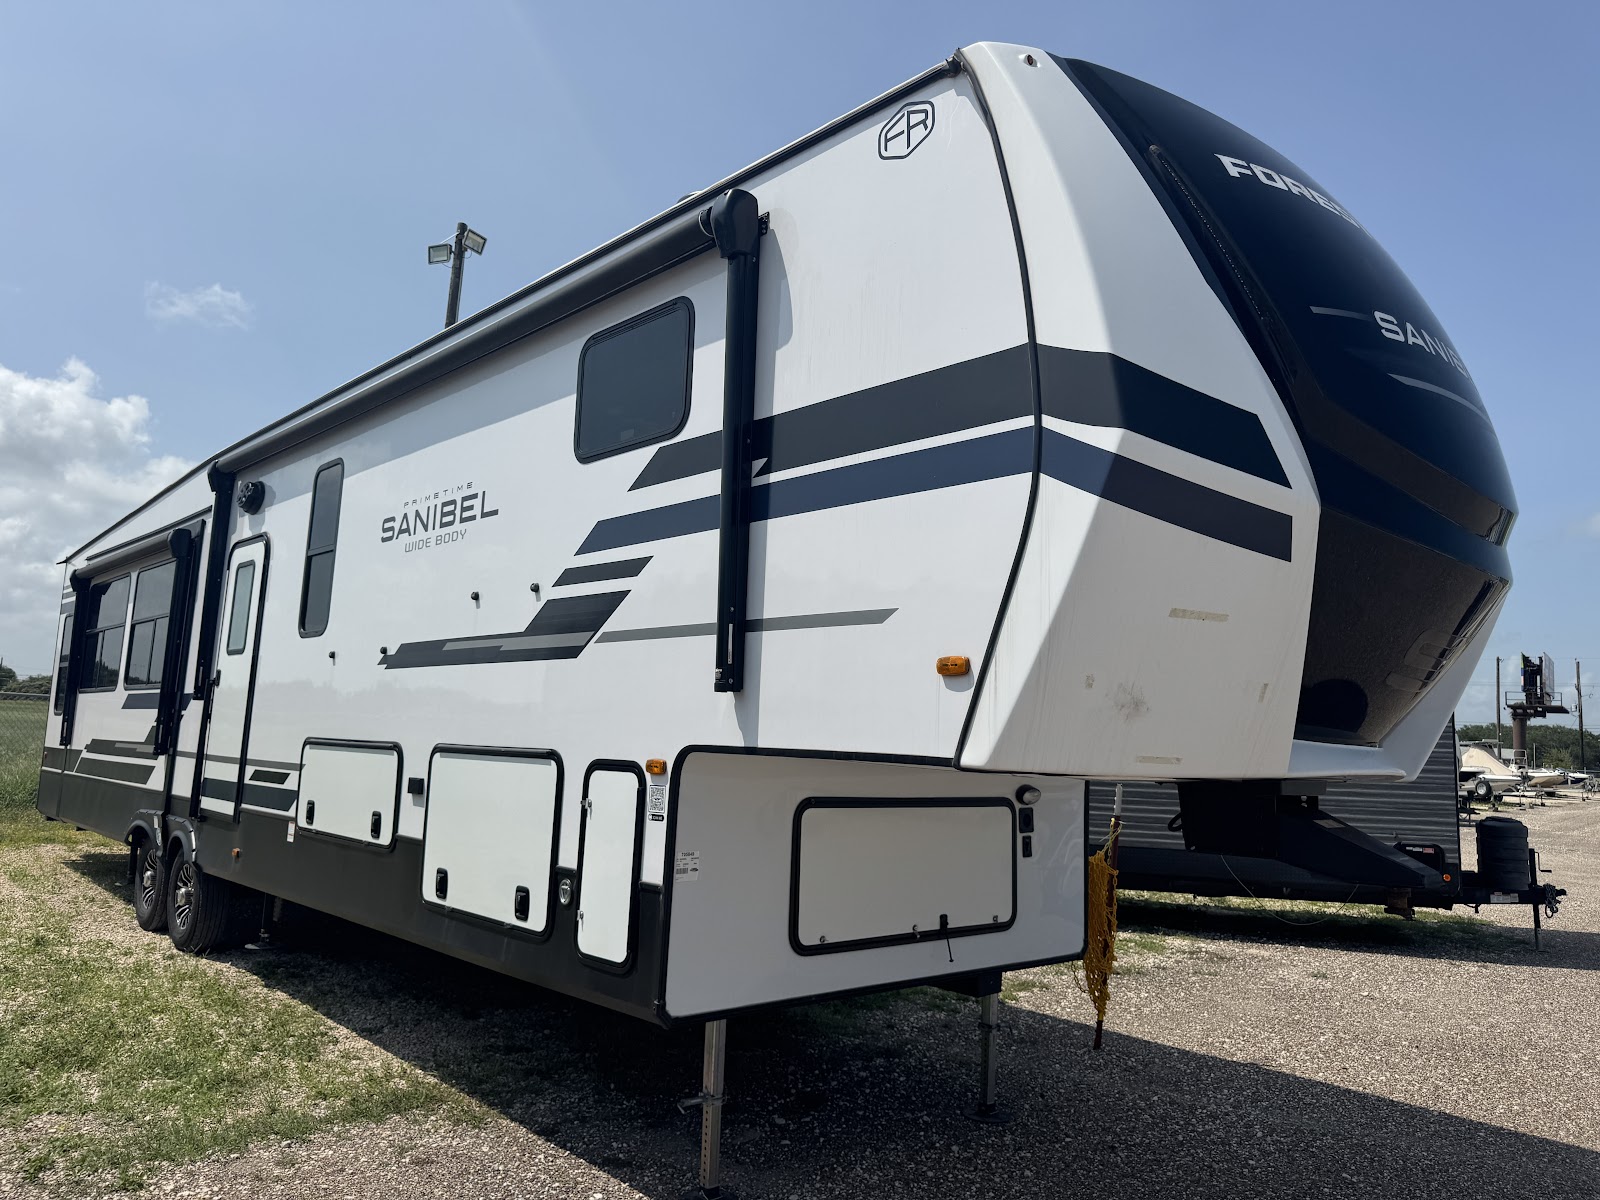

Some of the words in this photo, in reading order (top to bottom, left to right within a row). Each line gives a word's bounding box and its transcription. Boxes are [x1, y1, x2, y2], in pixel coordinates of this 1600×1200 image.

[1374, 310, 1474, 385] SANIB
[403, 482, 473, 508] PRIMETIME
[381, 491, 498, 543] SANIBEL
[404, 537, 431, 553] WIDE
[435, 529, 467, 546] BODY
